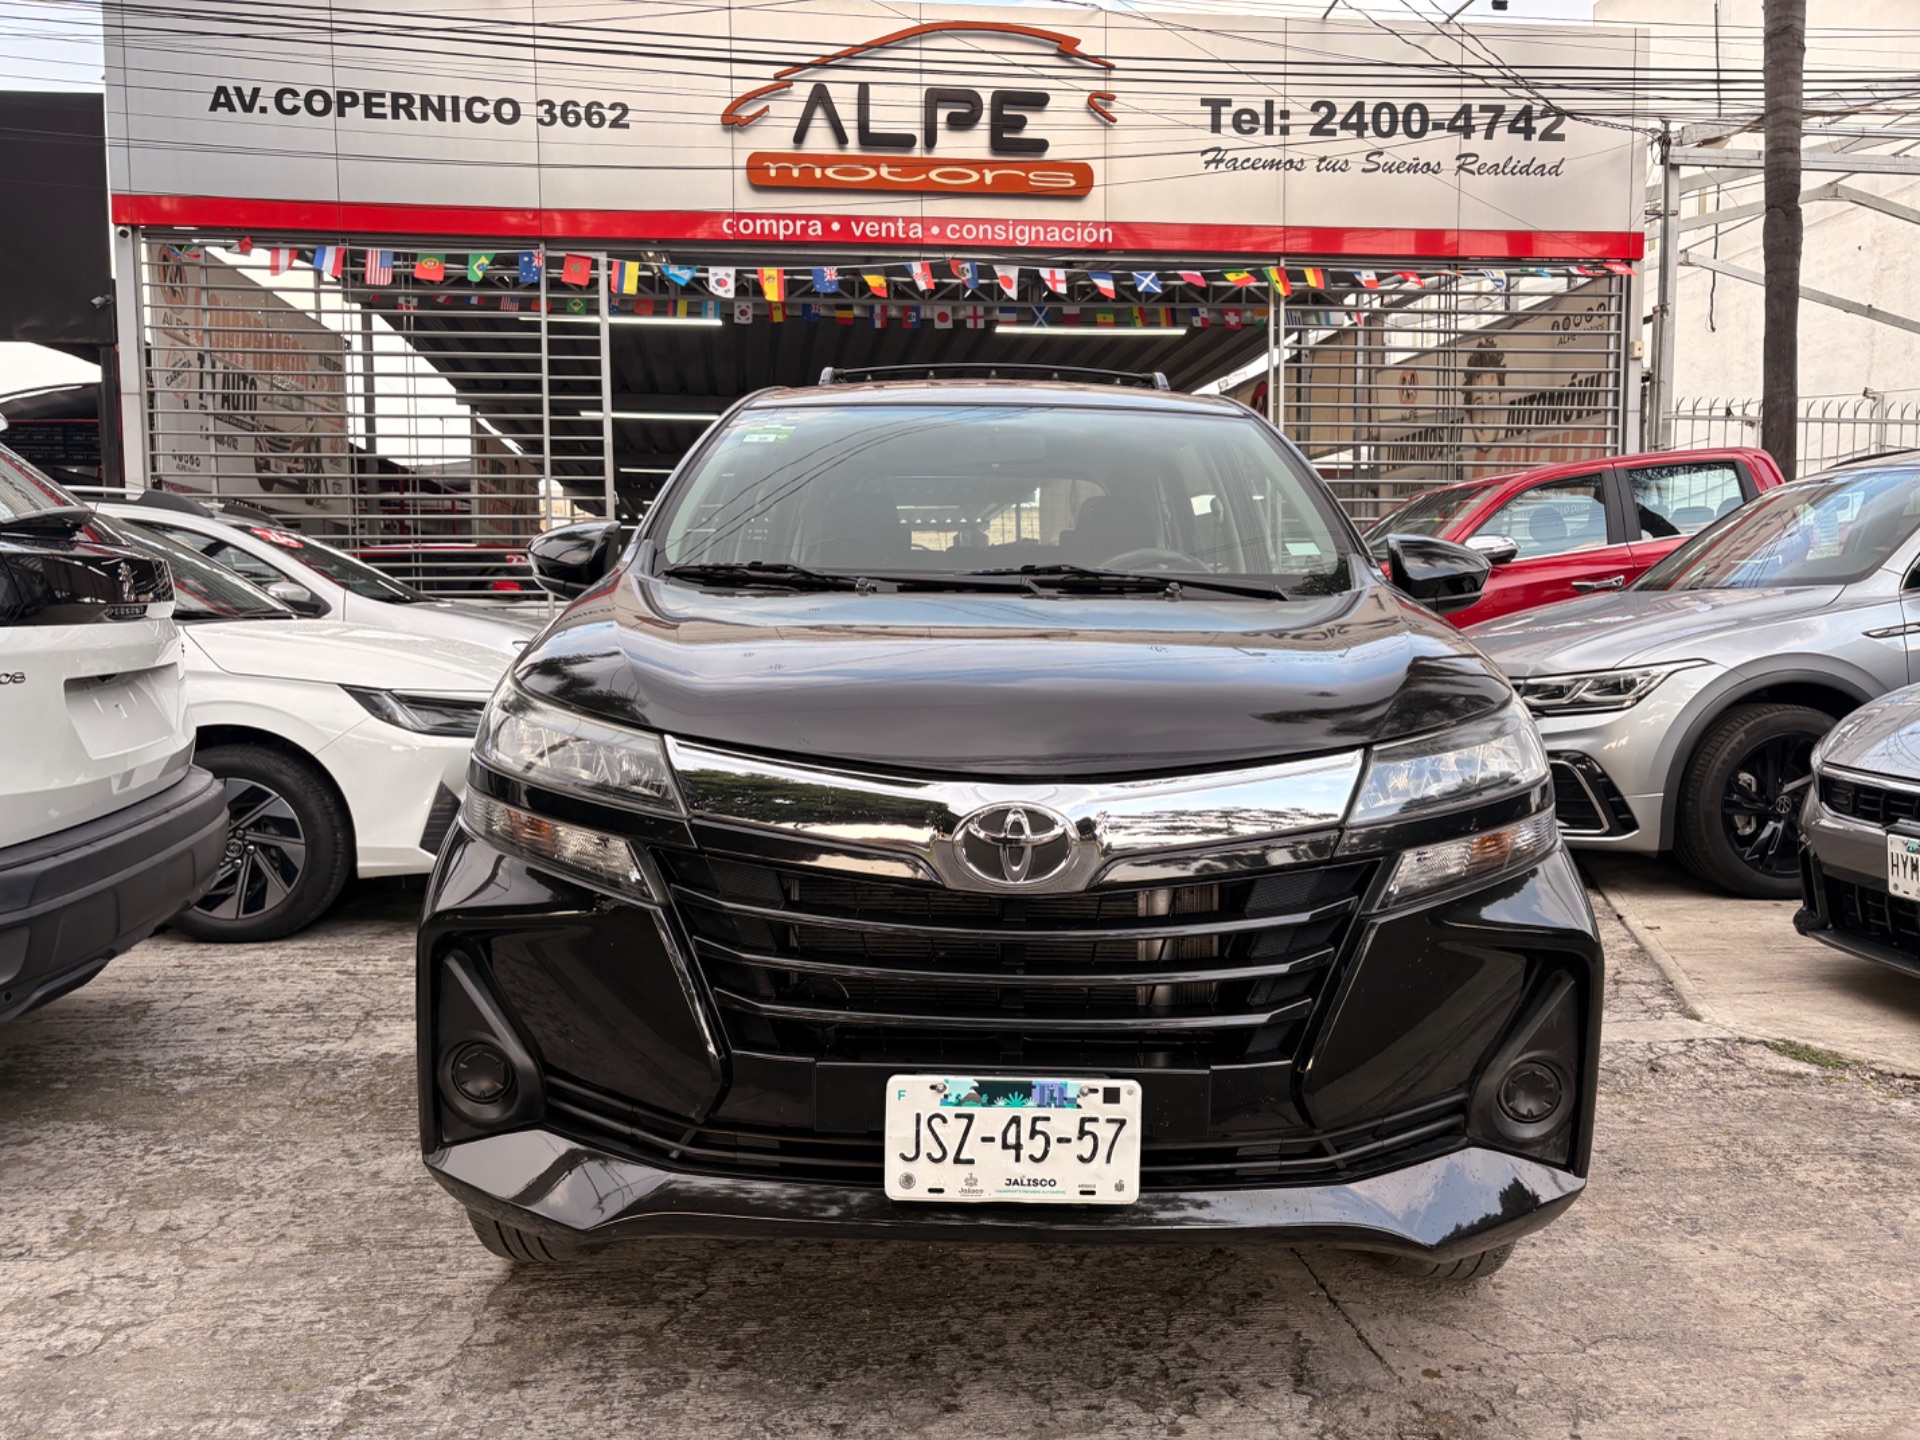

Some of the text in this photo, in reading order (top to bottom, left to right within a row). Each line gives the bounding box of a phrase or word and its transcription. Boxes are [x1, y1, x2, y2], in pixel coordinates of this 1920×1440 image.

[536, 99, 630, 129] 3662
[793, 83, 1050, 153] ALPE
[1200, 98, 1566, 142] Tel: 2400-4742
[762, 161, 1077, 190] motors
[1200, 146, 1564, 178] Hacemos tus Sueños Realidad
[722, 219, 1113, 245] compra venta consignación
[897, 1089, 907, 1101] F
[899, 1112, 1127, 1165] JSZ-45-57
[1004, 1178, 1057, 1188] JALISCO
